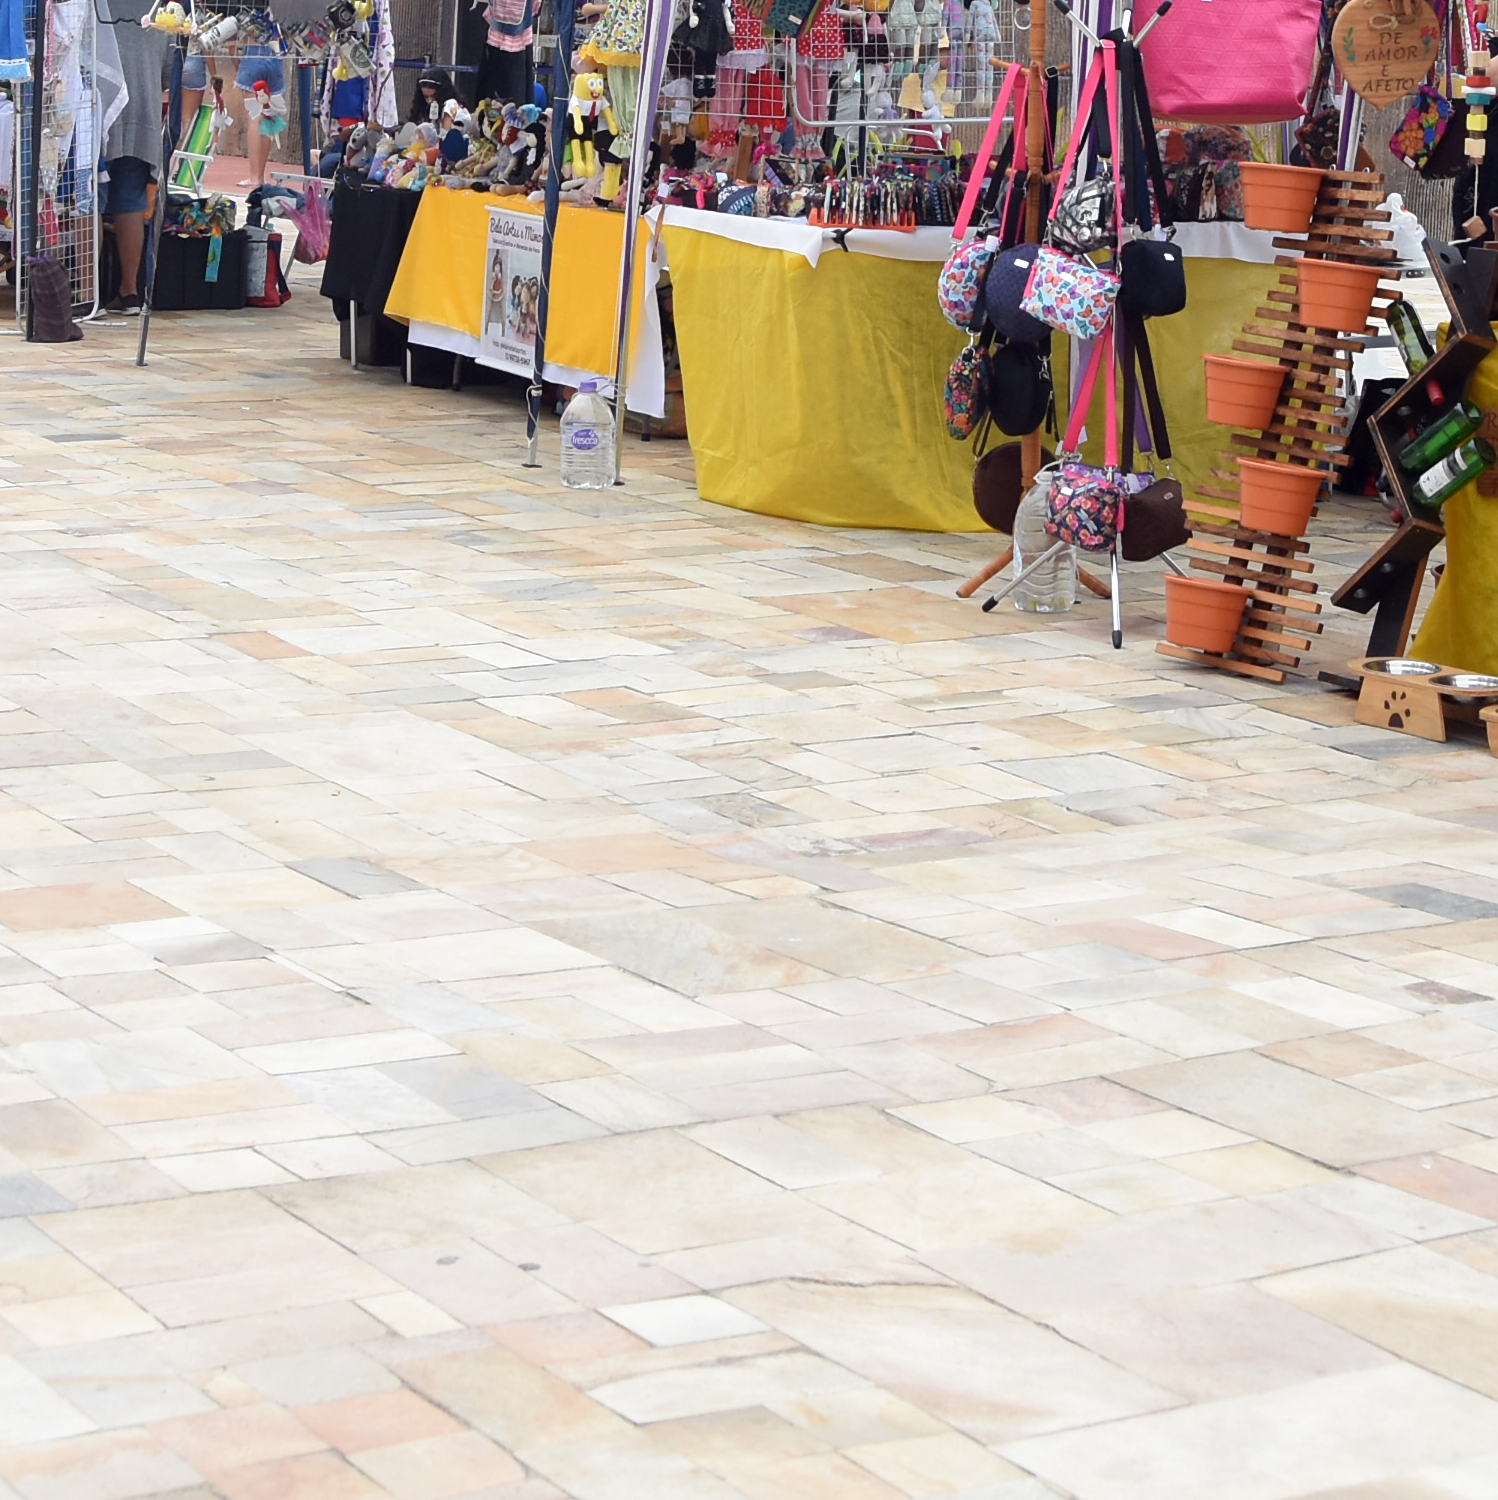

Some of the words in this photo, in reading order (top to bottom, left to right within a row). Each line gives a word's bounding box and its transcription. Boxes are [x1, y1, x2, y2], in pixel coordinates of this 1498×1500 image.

[1379, 31, 1403, 45] DE
[1365, 45, 1418, 61] AMOR
[1381, 64, 1390, 77] E
[1362, 77, 1415, 93] AFETO
